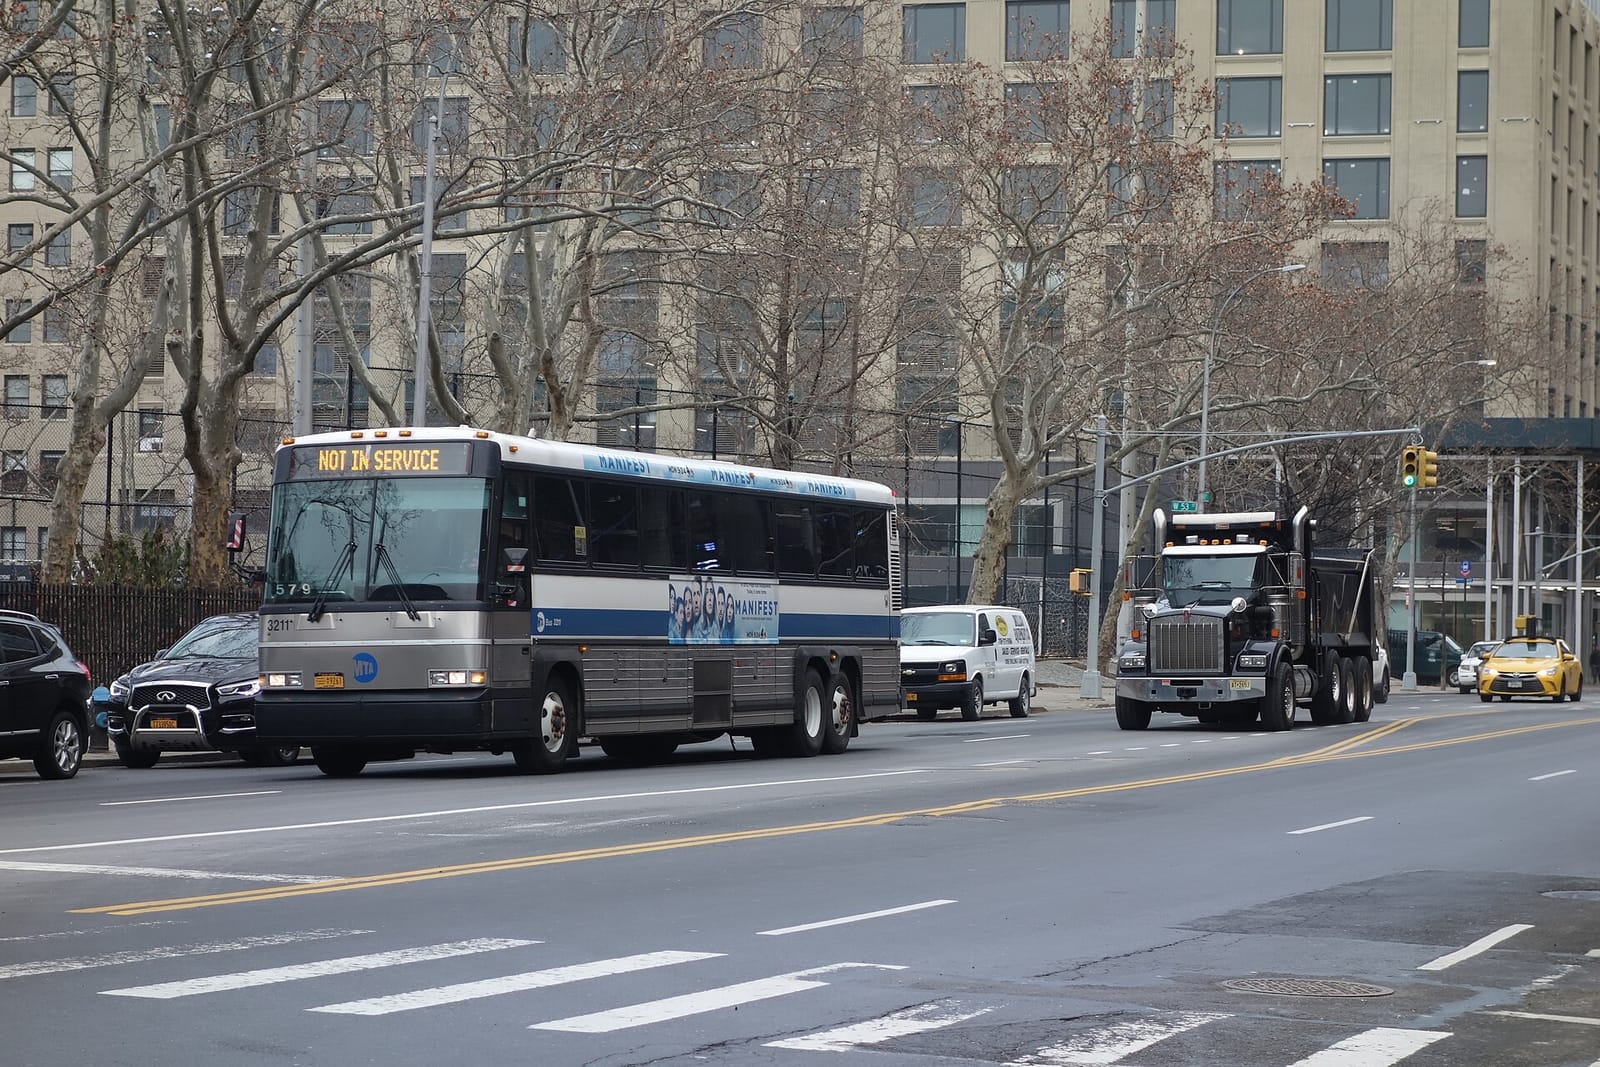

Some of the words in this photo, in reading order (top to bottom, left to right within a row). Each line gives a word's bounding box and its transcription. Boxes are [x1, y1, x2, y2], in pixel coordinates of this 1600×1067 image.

[318, 449, 346, 471] NOT
[351, 449, 369, 471] IN
[374, 449, 440, 471] SERVICE
[598, 455, 651, 474] MANIFEST
[1182, 502, 1190, 511] 53
[735, 599, 778, 616] MANIFEST
[267, 619, 289, 631] 3211
[354, 658, 374, 678] MTA
